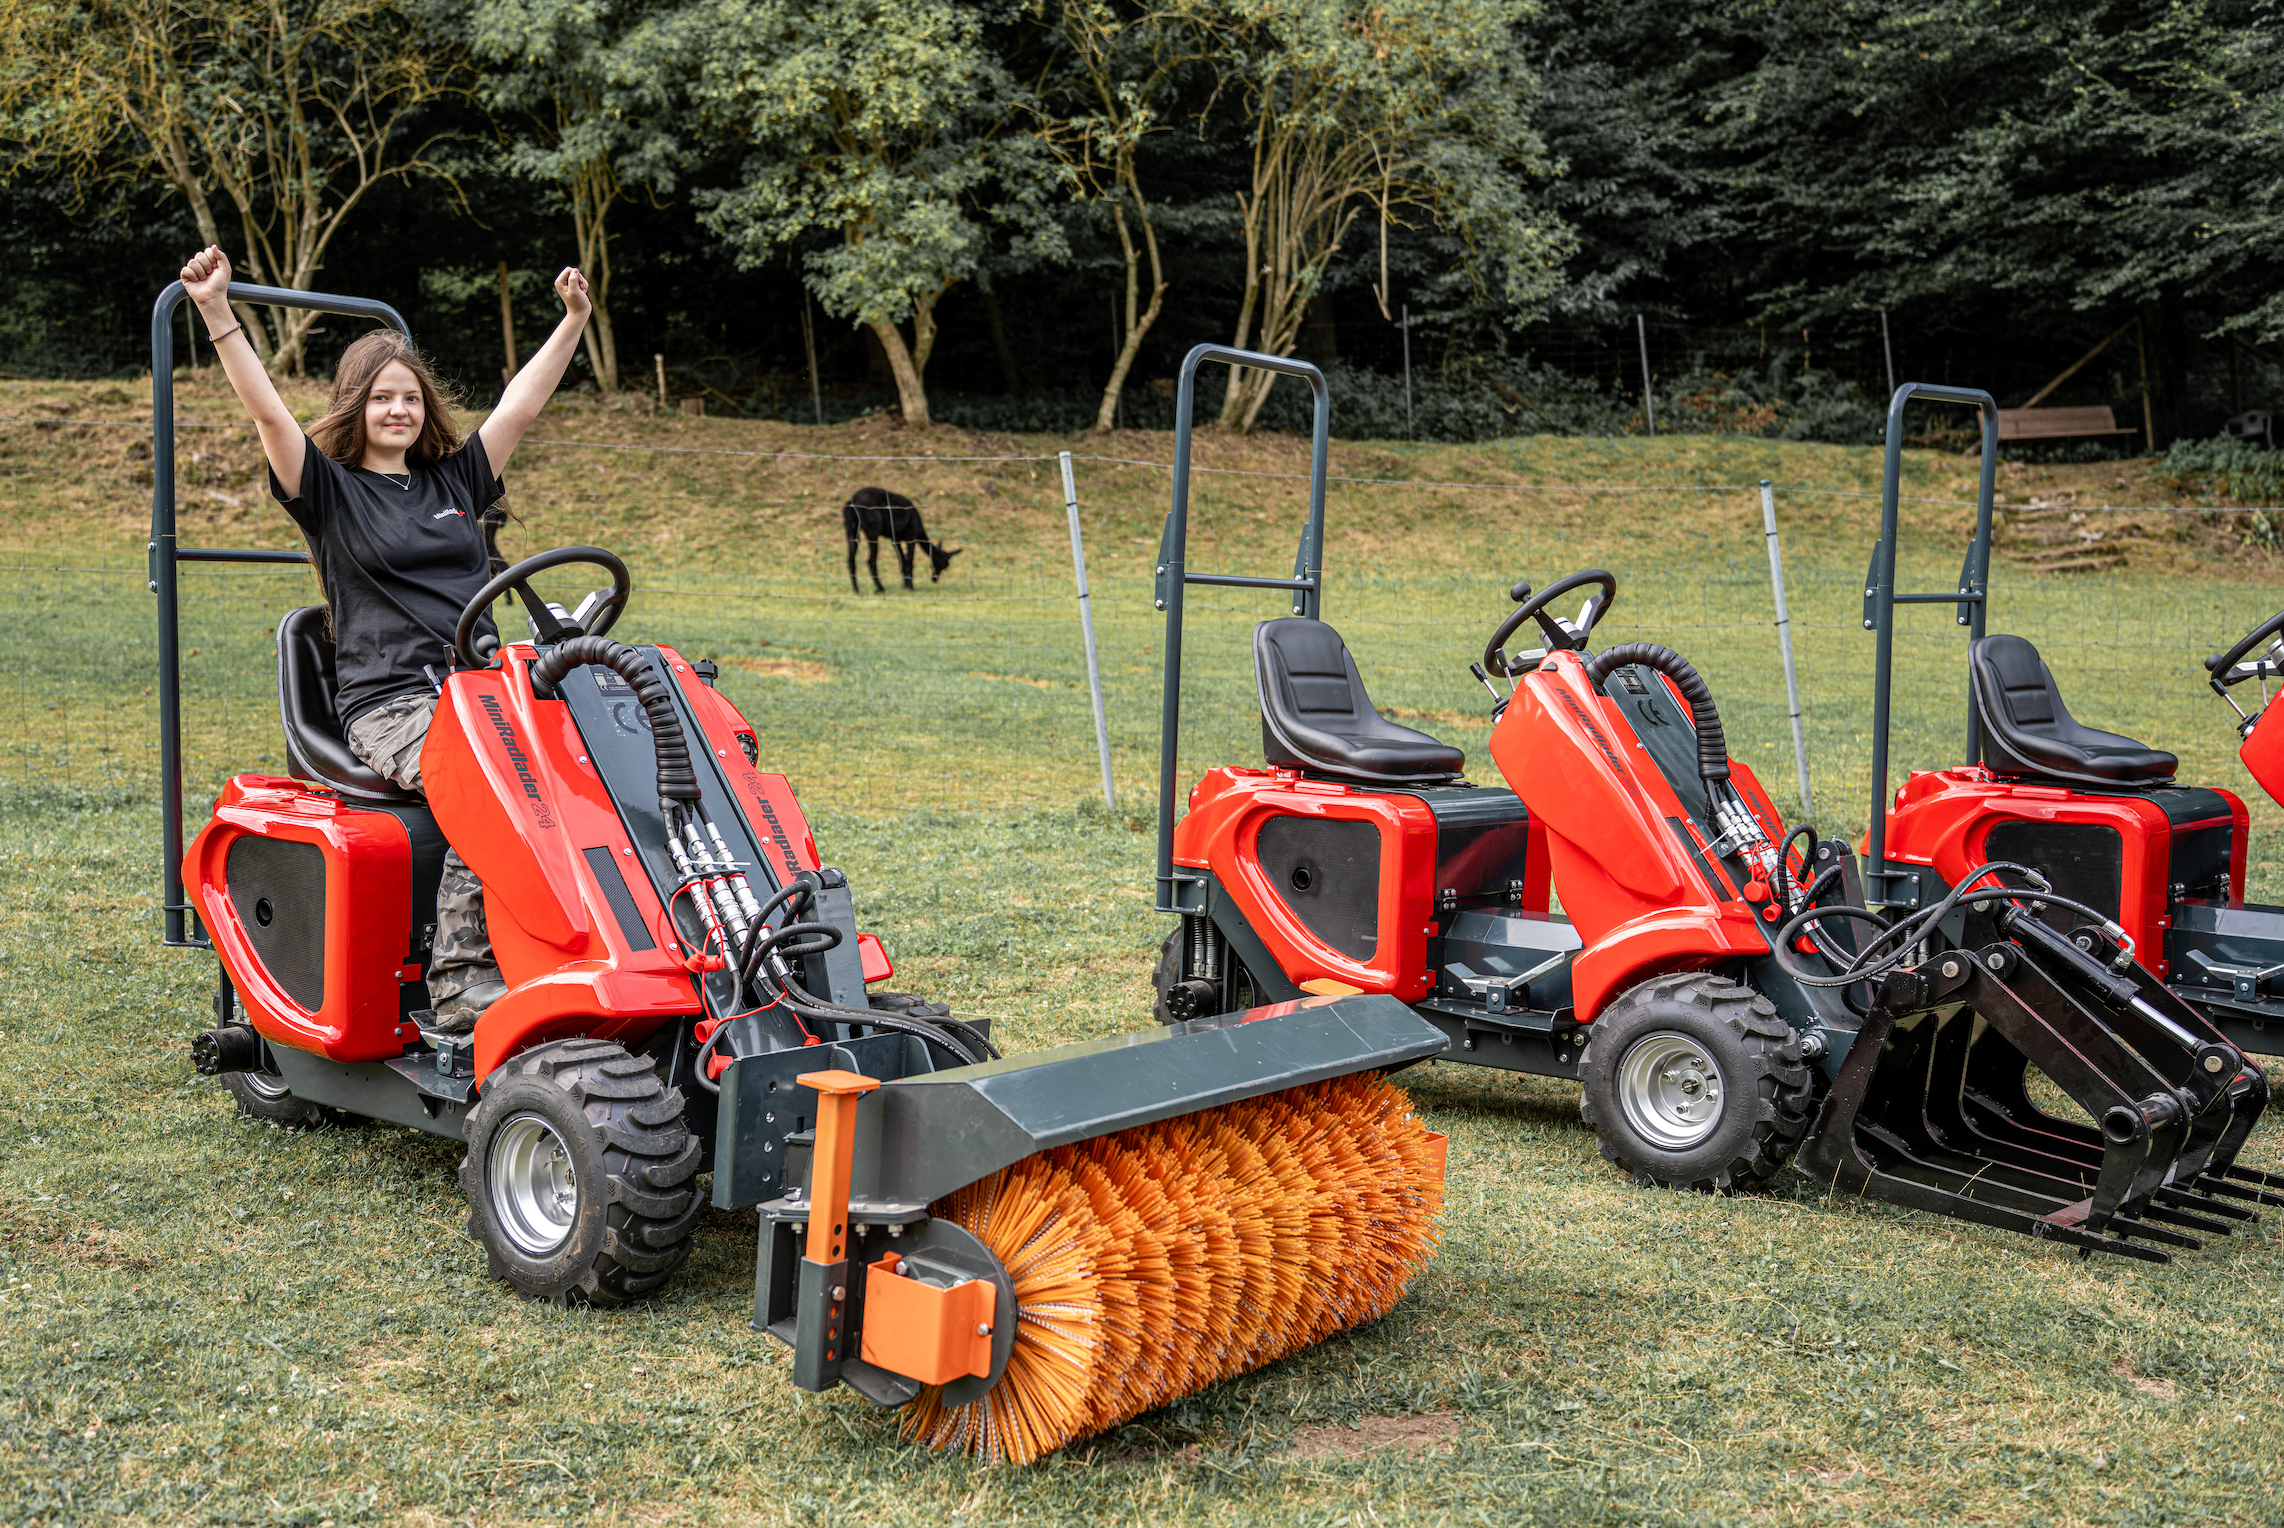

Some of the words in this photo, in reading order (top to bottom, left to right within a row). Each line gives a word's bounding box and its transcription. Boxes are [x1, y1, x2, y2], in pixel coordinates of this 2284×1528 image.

[478, 694, 542, 802] MiniRadlader
[531, 803, 556, 829] 24
[1556, 688, 1626, 776] MiniRadlader
[742, 772, 765, 795] 24
[756, 796, 802, 877] iRadlader
[557, 1103, 590, 1154] R-4
